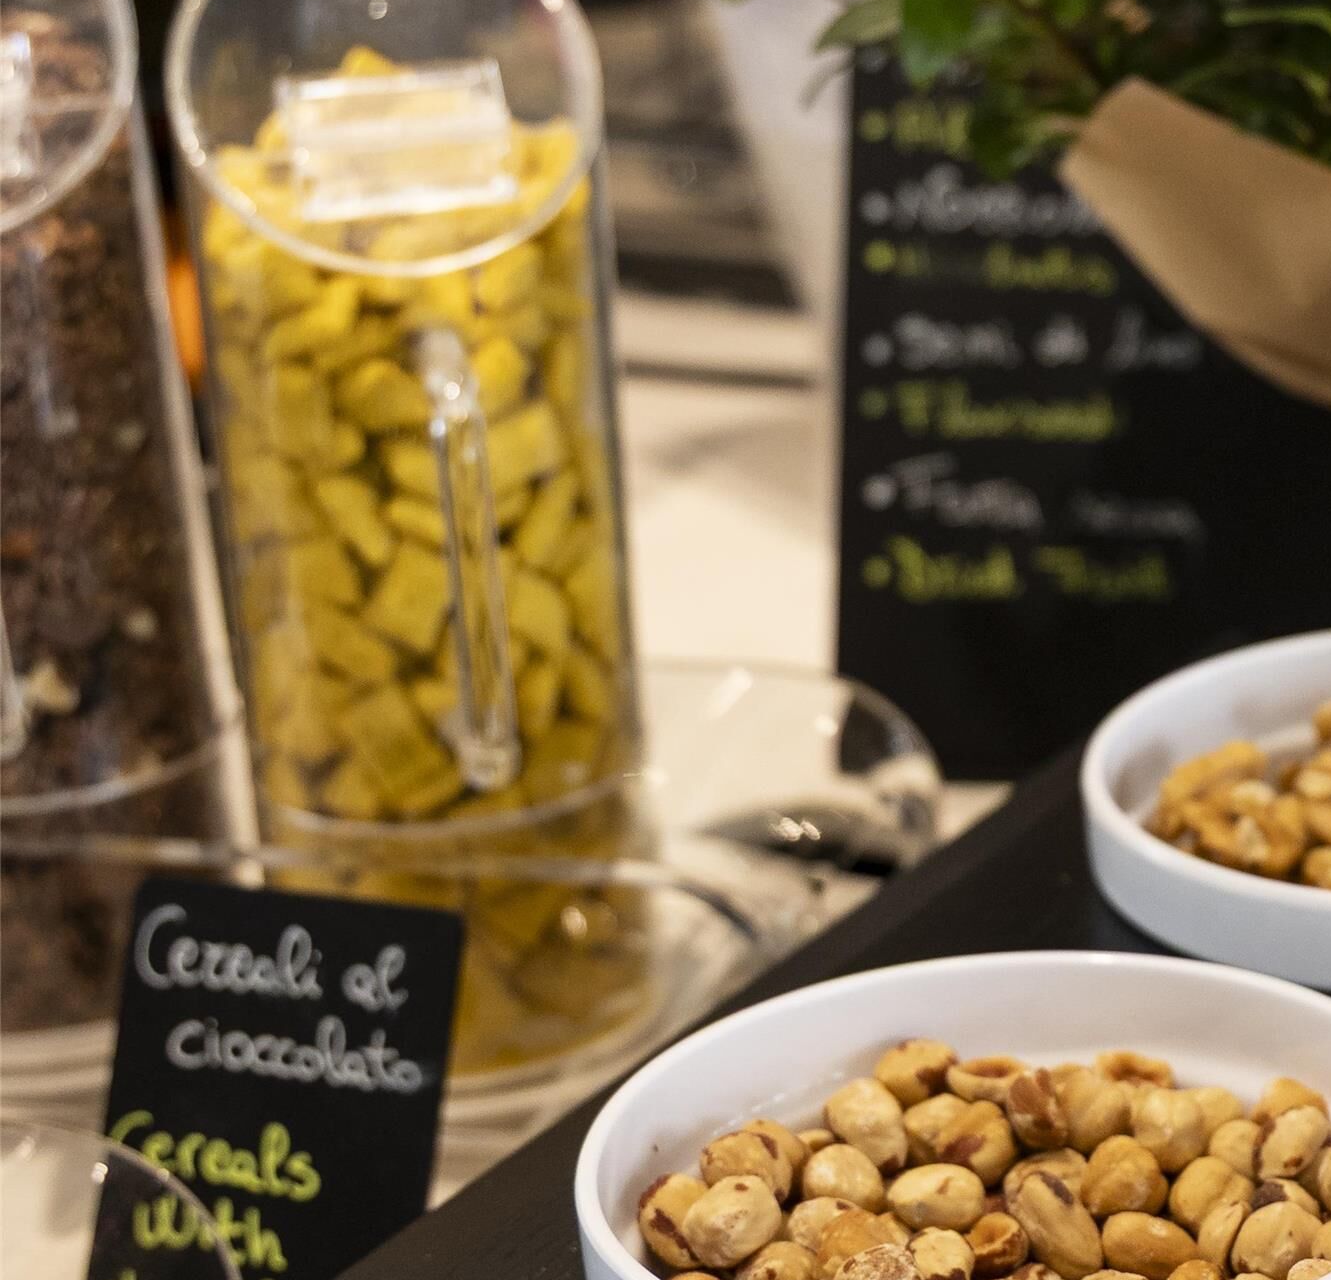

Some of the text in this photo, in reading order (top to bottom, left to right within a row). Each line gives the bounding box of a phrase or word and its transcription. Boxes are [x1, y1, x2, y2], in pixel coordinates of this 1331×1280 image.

[134, 903, 409, 1012] Cereali al
[166, 1015, 424, 1095] cioccolato
[108, 1109, 322, 1202] Cereals
